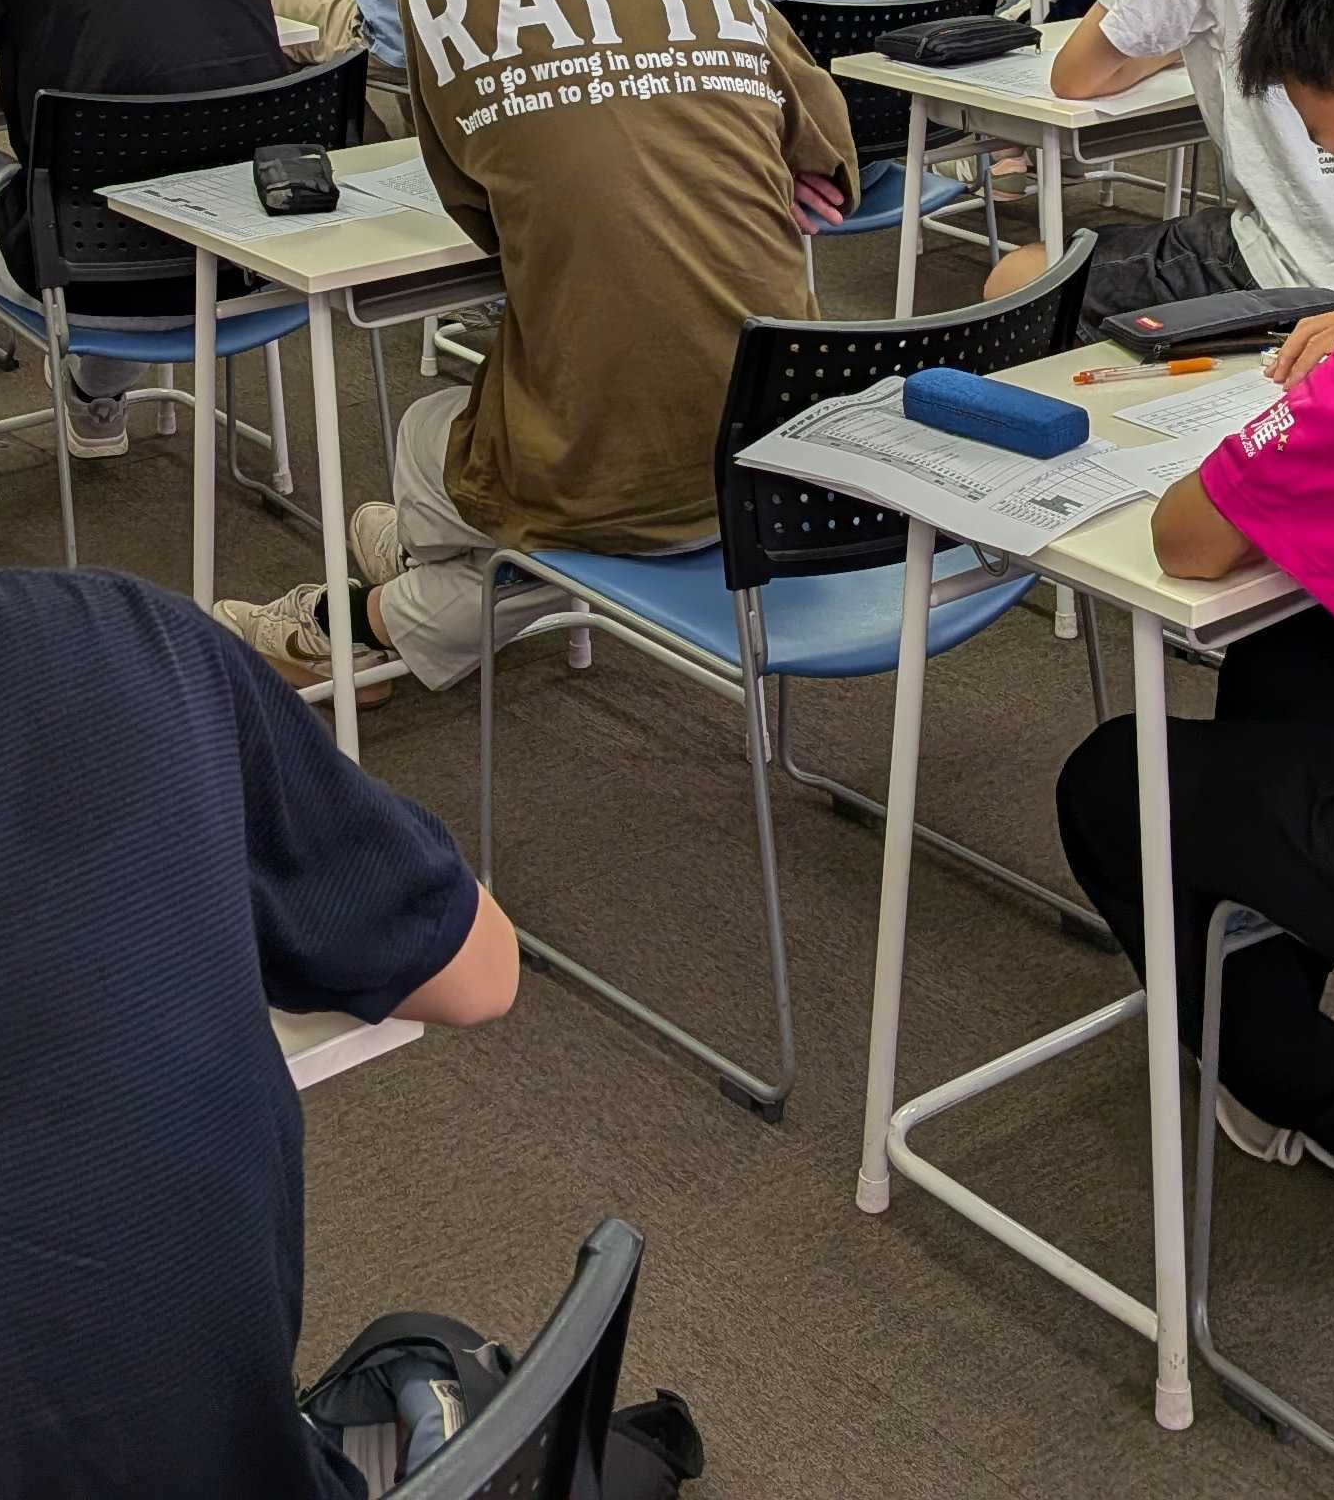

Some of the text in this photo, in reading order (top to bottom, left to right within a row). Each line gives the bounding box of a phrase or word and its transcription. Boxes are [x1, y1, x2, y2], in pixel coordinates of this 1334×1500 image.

[475, 75, 496, 96] to
[500, 65, 527, 94] go
[530, 51, 604, 82] wrong
[605, 50, 631, 71] in
[634, 46, 688, 70] one's
[691, 50, 730, 67] own
[731, 51, 759, 76] way
[501, 92, 555, 117] than
[557, 85, 582, 104] to
[587, 77, 615, 105] go
[619, 73, 672, 100] right
[673, 71, 697, 93] in
[700, 75, 766, 98] someone
[1320, 166, 1334, 175] YOU
